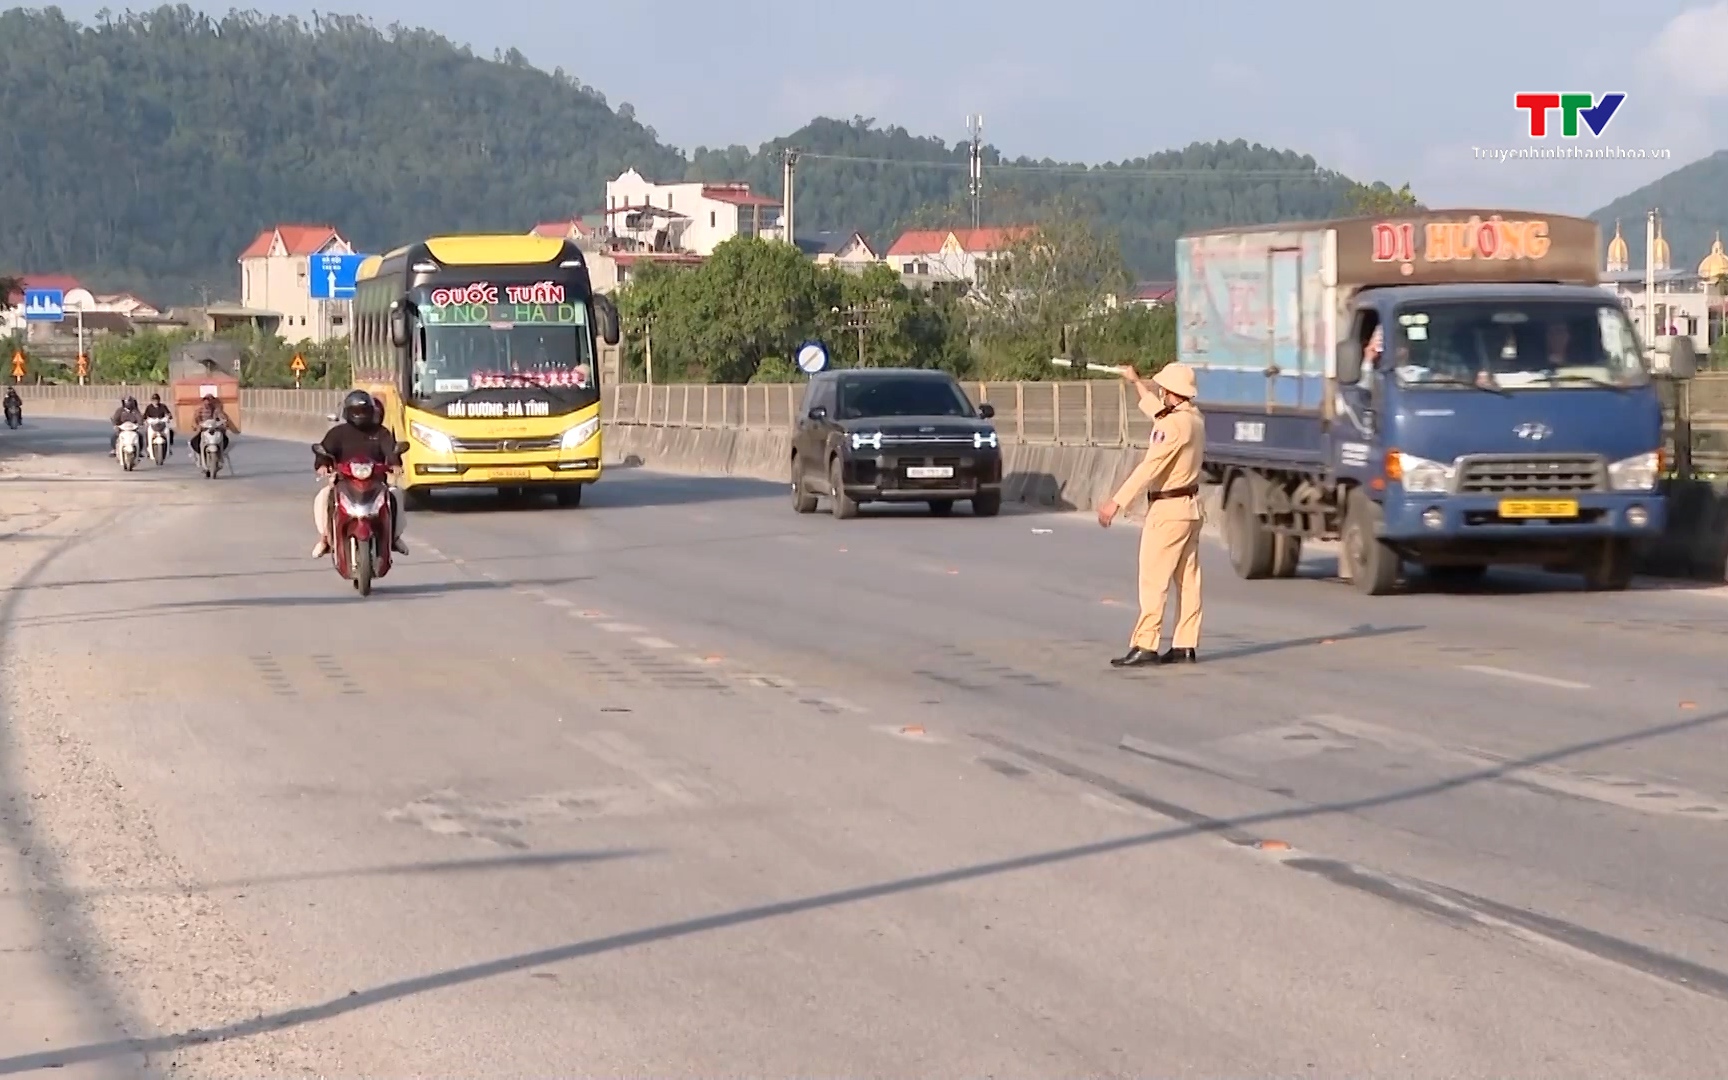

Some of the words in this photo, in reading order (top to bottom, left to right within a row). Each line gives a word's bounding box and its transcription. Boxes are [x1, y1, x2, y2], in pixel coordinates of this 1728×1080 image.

[1372, 222, 1416, 276] DỊ
[431, 281, 498, 308] QUỐC
[505, 281, 565, 304] TUẤN
